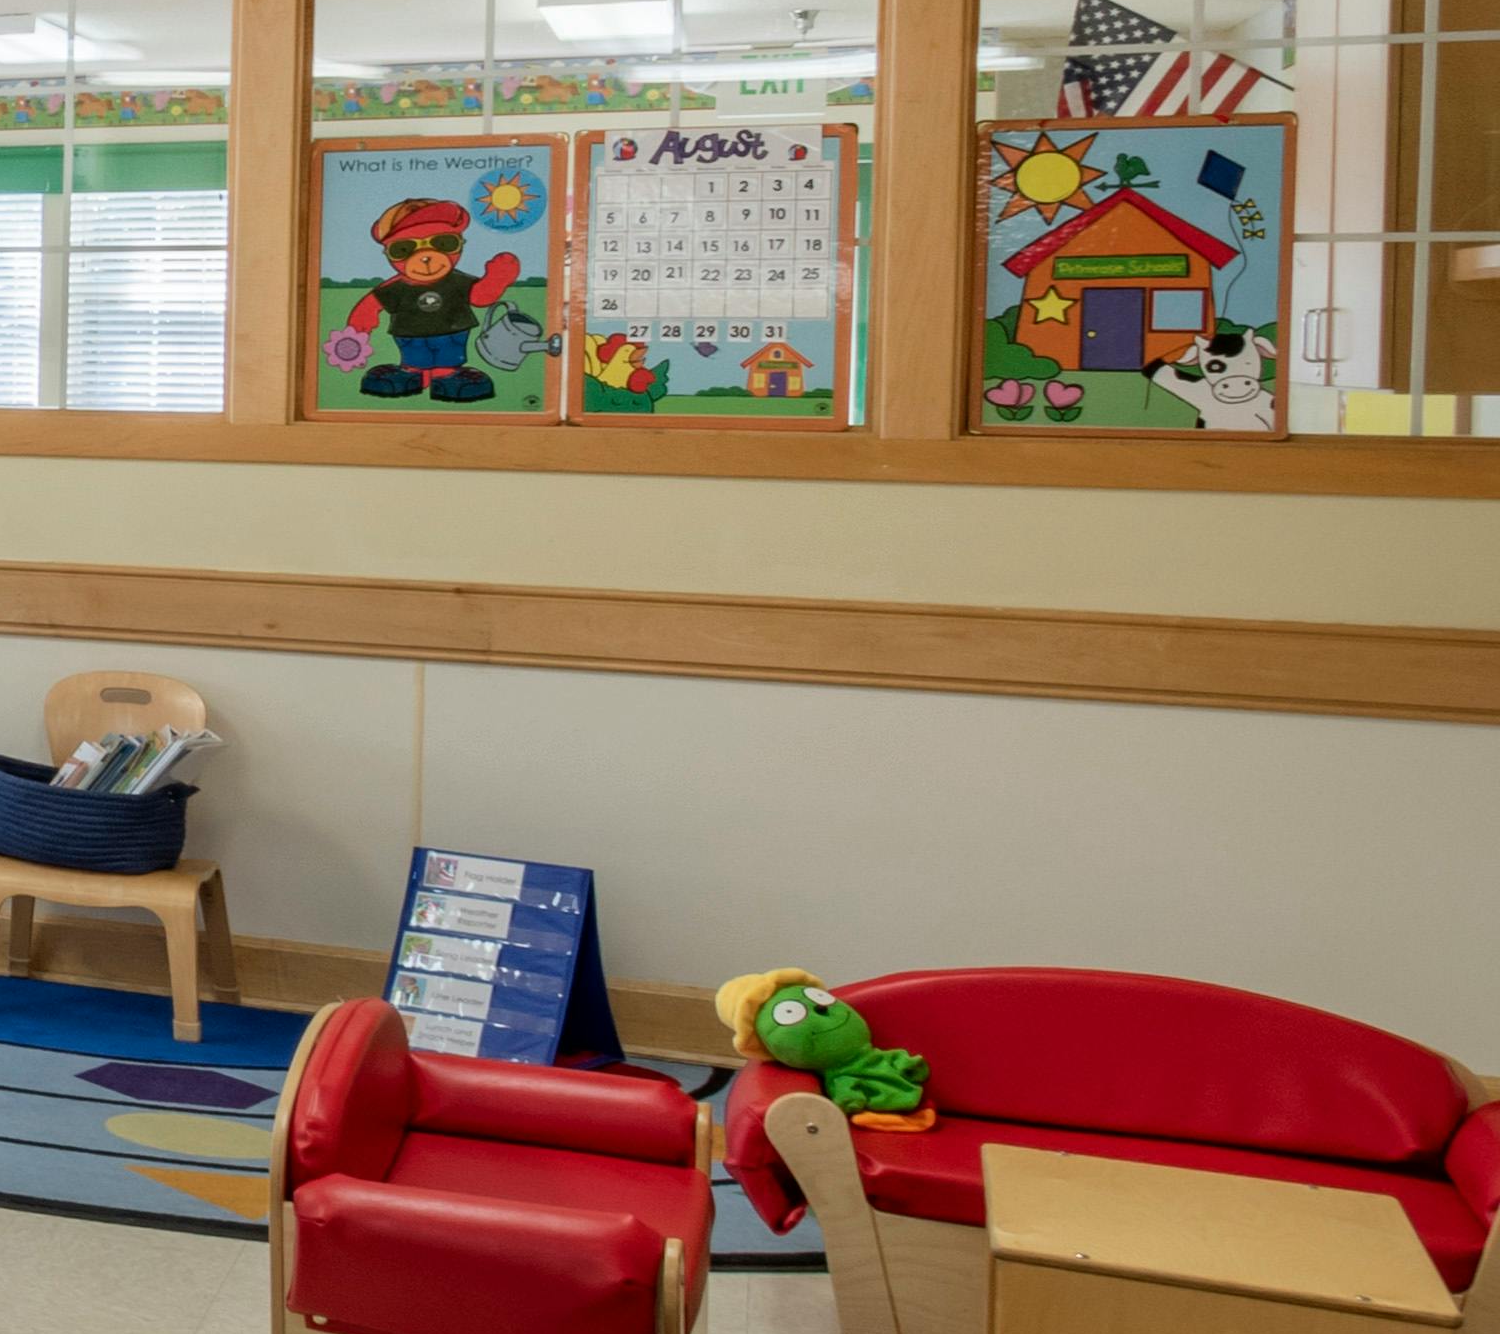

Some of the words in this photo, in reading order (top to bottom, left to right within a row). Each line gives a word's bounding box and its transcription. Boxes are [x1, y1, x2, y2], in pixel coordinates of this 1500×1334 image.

[649, 129, 769, 165] August
[339, 158, 386, 172] What
[391, 158, 403, 171] is
[409, 157, 438, 171] the
[444, 154, 533, 170] Weather?
[708, 181, 714, 193] 1
[739, 180, 749, 193] 2
[773, 179, 783, 192] 3
[804, 178, 814, 191] 4
[606, 212, 615, 225] 5
[638, 211, 647, 224] 6
[670, 211, 679, 224] 7
[705, 210, 715, 223] 8
[741, 208, 751, 221] 9
[769, 207, 786, 220] 10
[804, 209, 820, 221] 11
[603, 240, 618, 252] 12
[636, 241, 652, 254] 13
[667, 240, 684, 252] 14
[702, 240, 719, 252] 15
[733, 240, 750, 252] 16
[768, 238, 785, 251] 17
[805, 239, 822, 252] 18
[603, 269, 618, 281] 19
[631, 268, 651, 282] 20
[666, 267, 683, 279] 21
[700, 269, 720, 282] 22
[734, 268, 752, 281] 23
[767, 269, 786, 282] 24
[802, 267, 820, 280] 25
[601, 298, 618, 311] 26
[630, 325, 649, 338] 27
[662, 325, 681, 338] 28
[696, 325, 716, 338] 29
[729, 325, 750, 338] 30
[765, 325, 784, 338] 31
